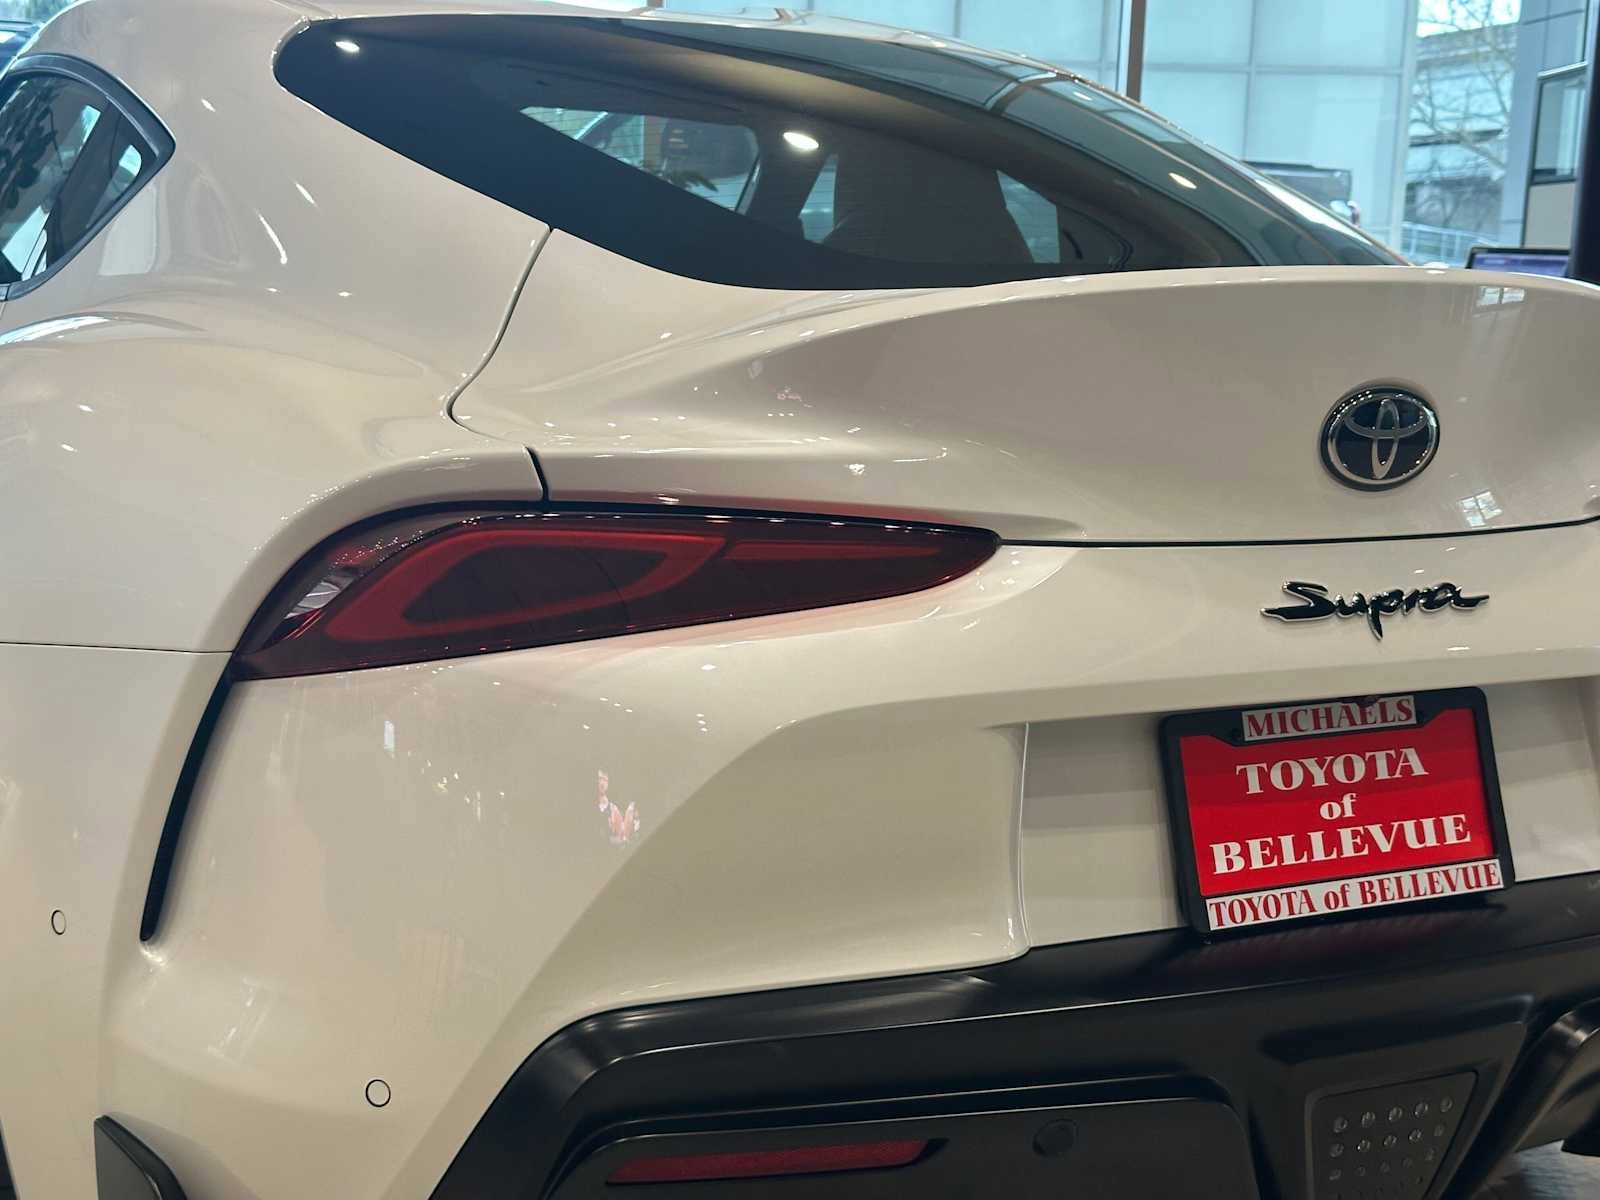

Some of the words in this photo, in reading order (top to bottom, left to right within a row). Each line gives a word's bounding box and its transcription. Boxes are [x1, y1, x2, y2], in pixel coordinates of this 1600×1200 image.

[1260, 581, 1490, 640] Supra
[1246, 698, 1413, 738] MICHAELS
[1236, 747, 1429, 794] TOYOTA
[1319, 793, 1356, 820] of
[1209, 814, 1471, 875] BELLEVUE
[1209, 891, 1315, 927] TOYOTA
[1324, 882, 1350, 910] of
[1358, 862, 1501, 906] BELLEVUE
